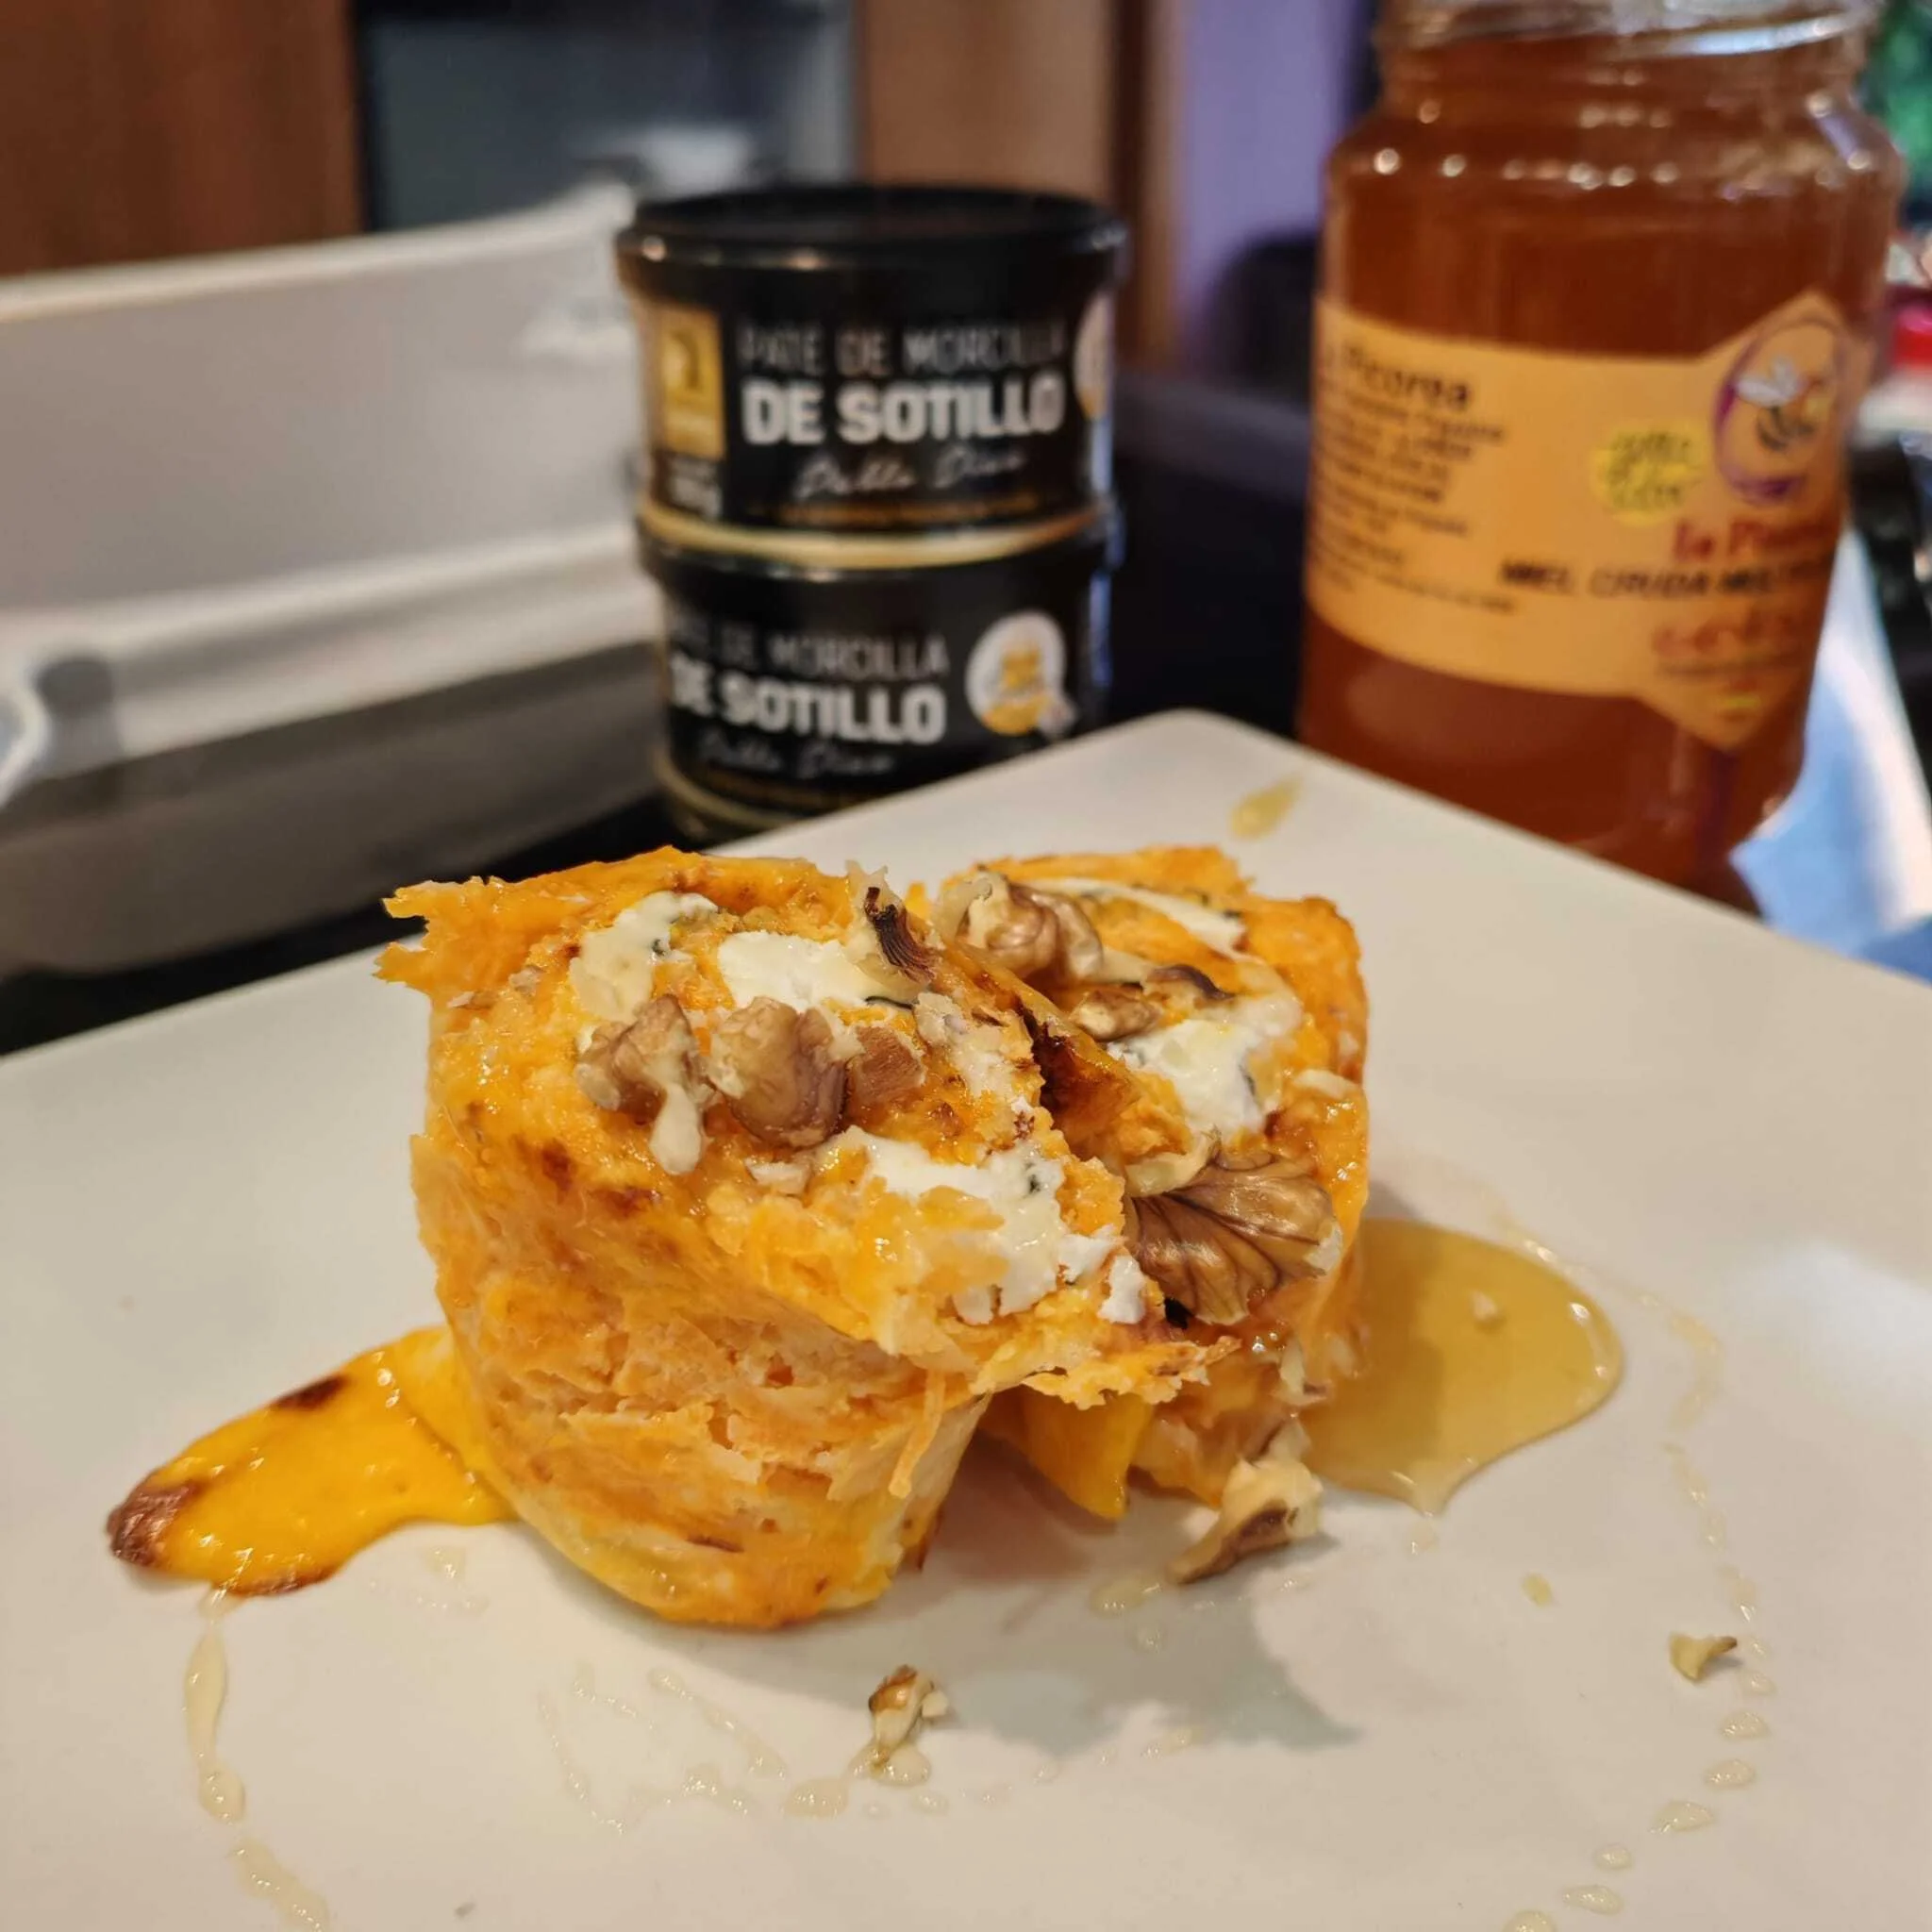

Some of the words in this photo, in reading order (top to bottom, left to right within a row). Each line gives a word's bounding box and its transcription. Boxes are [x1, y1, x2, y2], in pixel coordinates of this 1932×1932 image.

[836, 321, 890, 375] DE
[743, 379, 824, 443] DE
[837, 373, 1065, 442] SOTILLO
[766, 630, 950, 682] MORCILLA
[719, 671, 949, 744] SOTILLO
